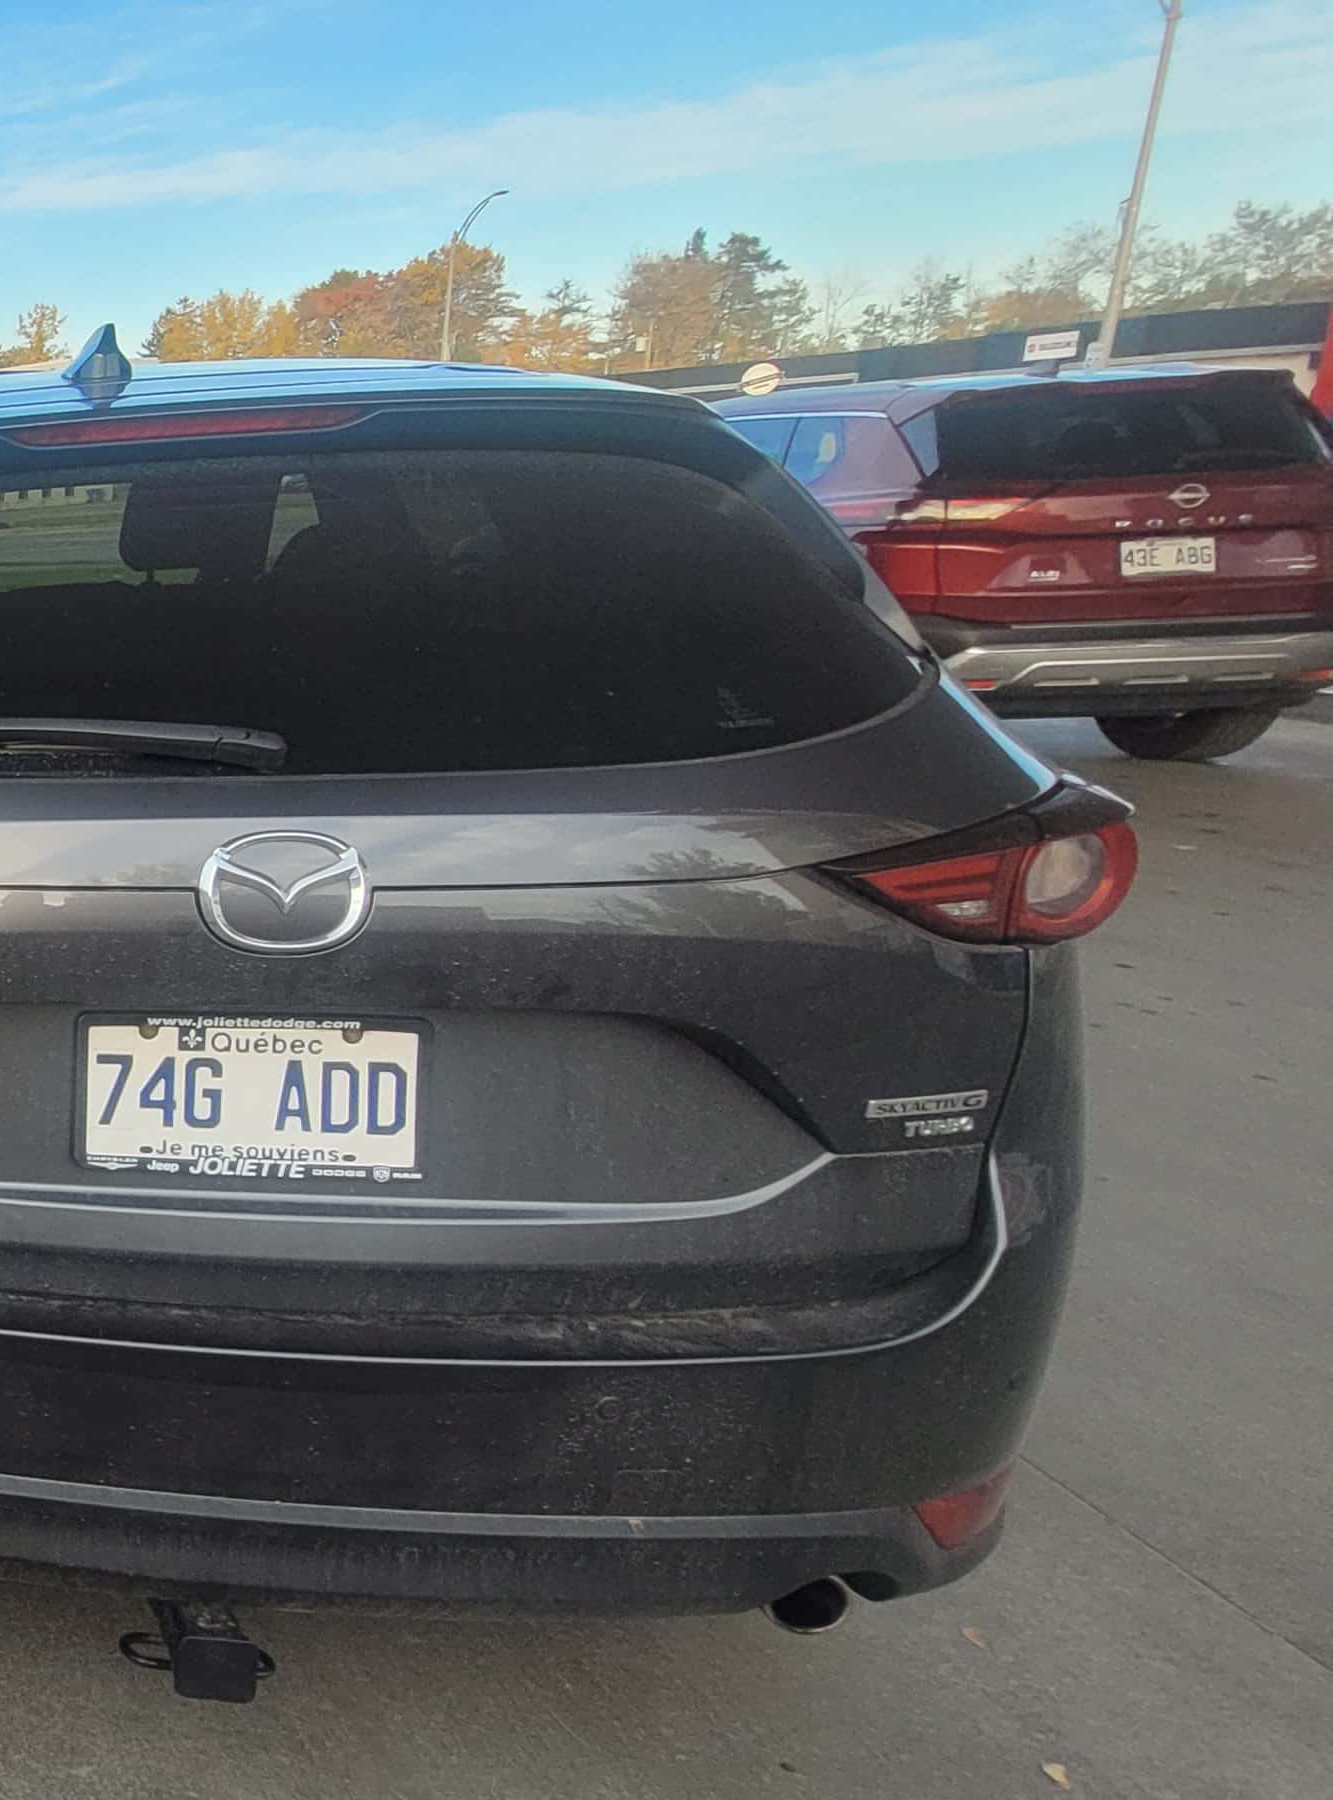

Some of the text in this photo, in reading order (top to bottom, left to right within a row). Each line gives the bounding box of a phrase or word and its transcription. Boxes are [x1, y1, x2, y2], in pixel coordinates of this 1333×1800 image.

[1123, 545, 1213, 568] 43E ABG
[146, 1017, 361, 1030] www.joliettedodge.com
[211, 1031, 324, 1055] Québec
[96, 1053, 408, 1136] 74G ADD
[904, 1116, 974, 1138] TURBO
[155, 1139, 340, 1162] Je me souviens
[146, 1160, 180, 1174] Jeep
[189, 1156, 306, 1178] JOLIETTE
